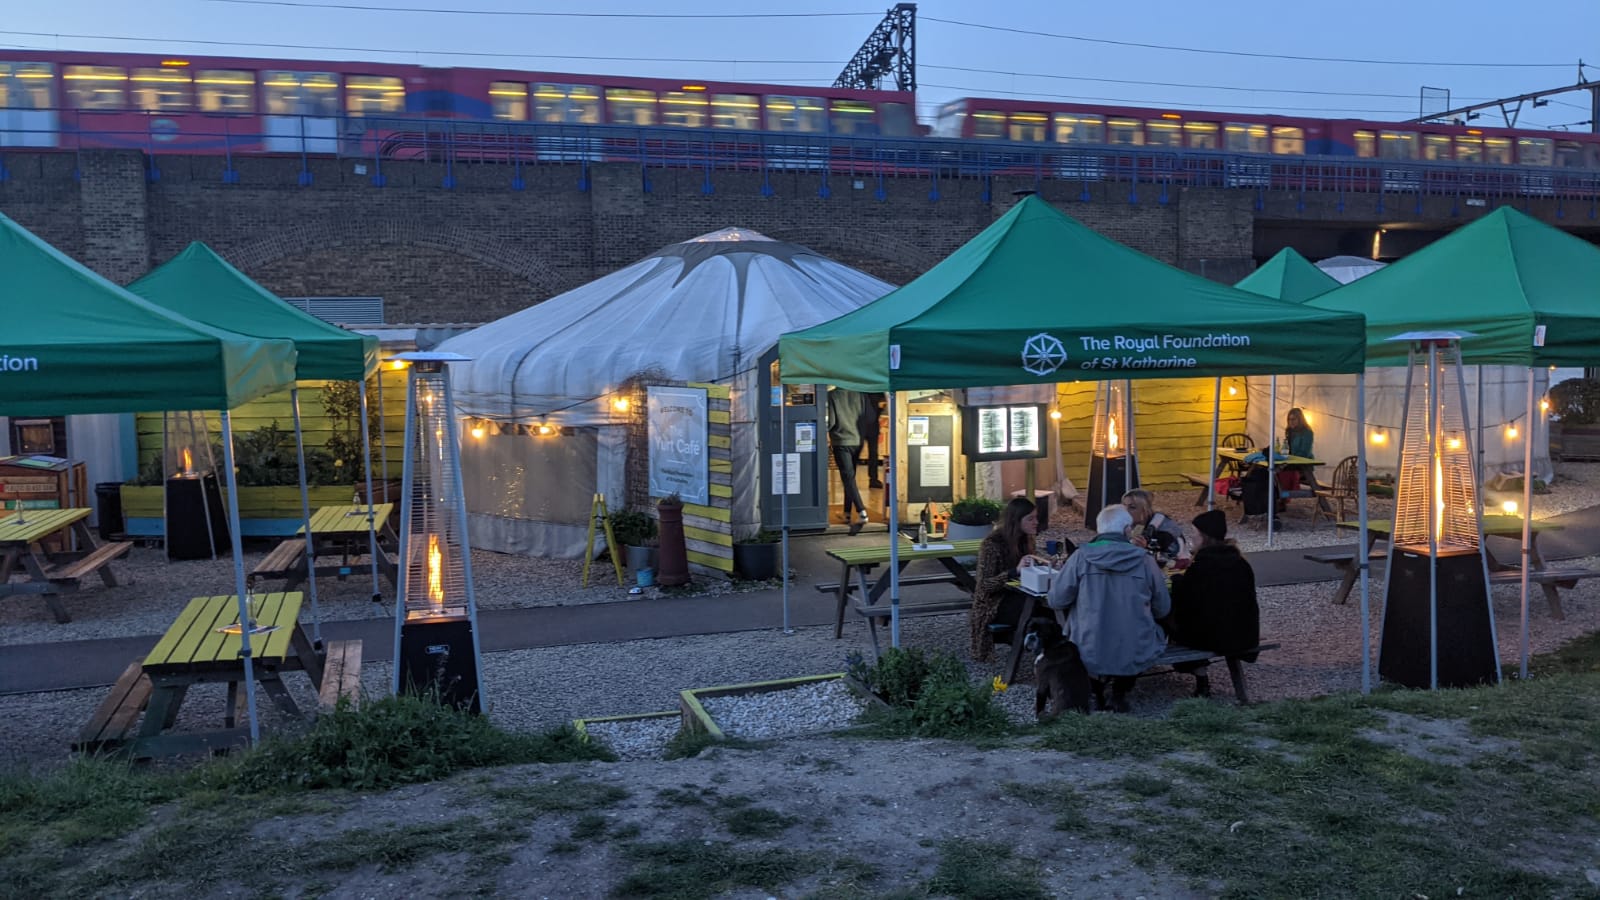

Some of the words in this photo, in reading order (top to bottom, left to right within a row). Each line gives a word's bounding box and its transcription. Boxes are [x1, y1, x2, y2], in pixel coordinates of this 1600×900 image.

[1080, 336, 1110, 350] The
[1114, 335, 1160, 353] Royal
[1162, 333, 1250, 349] Foundation
[1081, 357, 1099, 370] of
[1100, 357, 1118, 369] St
[1121, 355, 1197, 369] Katharine
[676, 439, 700, 455] Café
